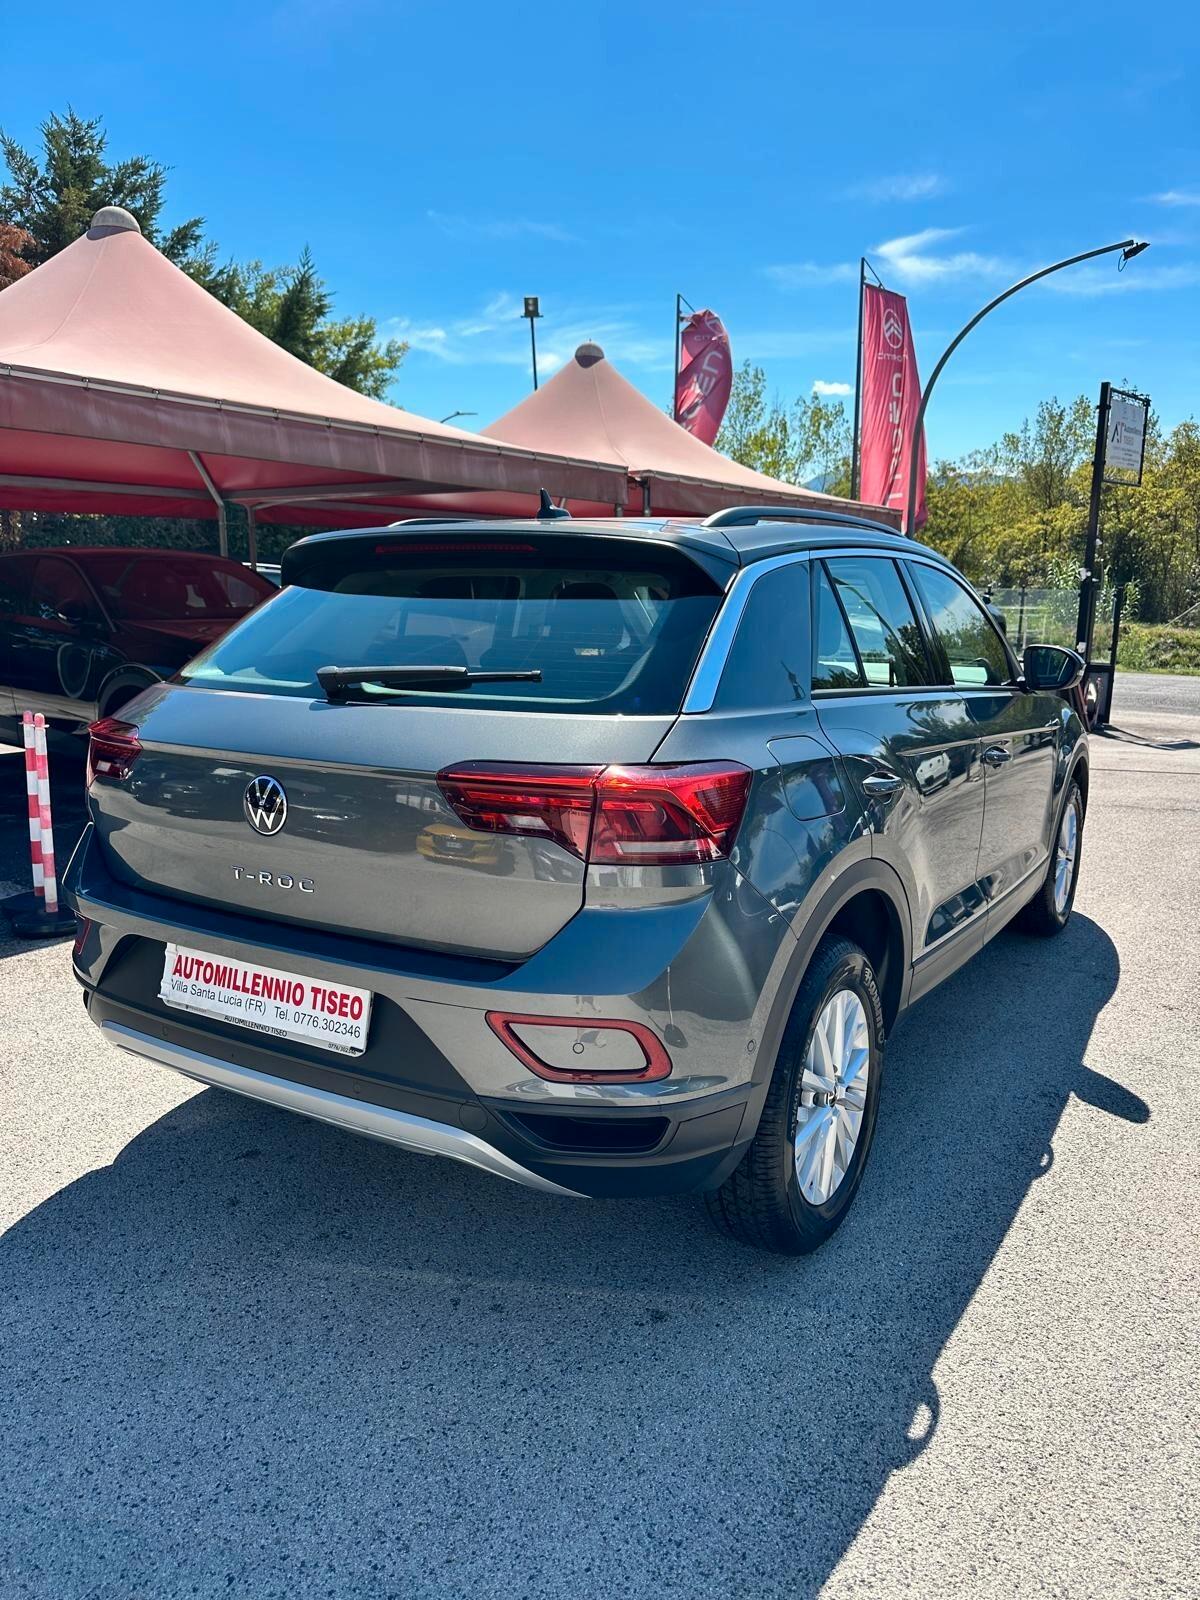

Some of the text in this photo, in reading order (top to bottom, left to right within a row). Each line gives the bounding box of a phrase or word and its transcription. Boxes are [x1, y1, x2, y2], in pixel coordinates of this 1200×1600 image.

[232, 865, 314, 893] T-ROC
[171, 978, 361, 1039] Villa Santa Lucia (FR) Tel. 0776.302346
[172, 954, 363, 1020] AUTOMILLENNIO TISEO
[224, 1015, 288, 1038] AUTOMILLENNIO TISEO
